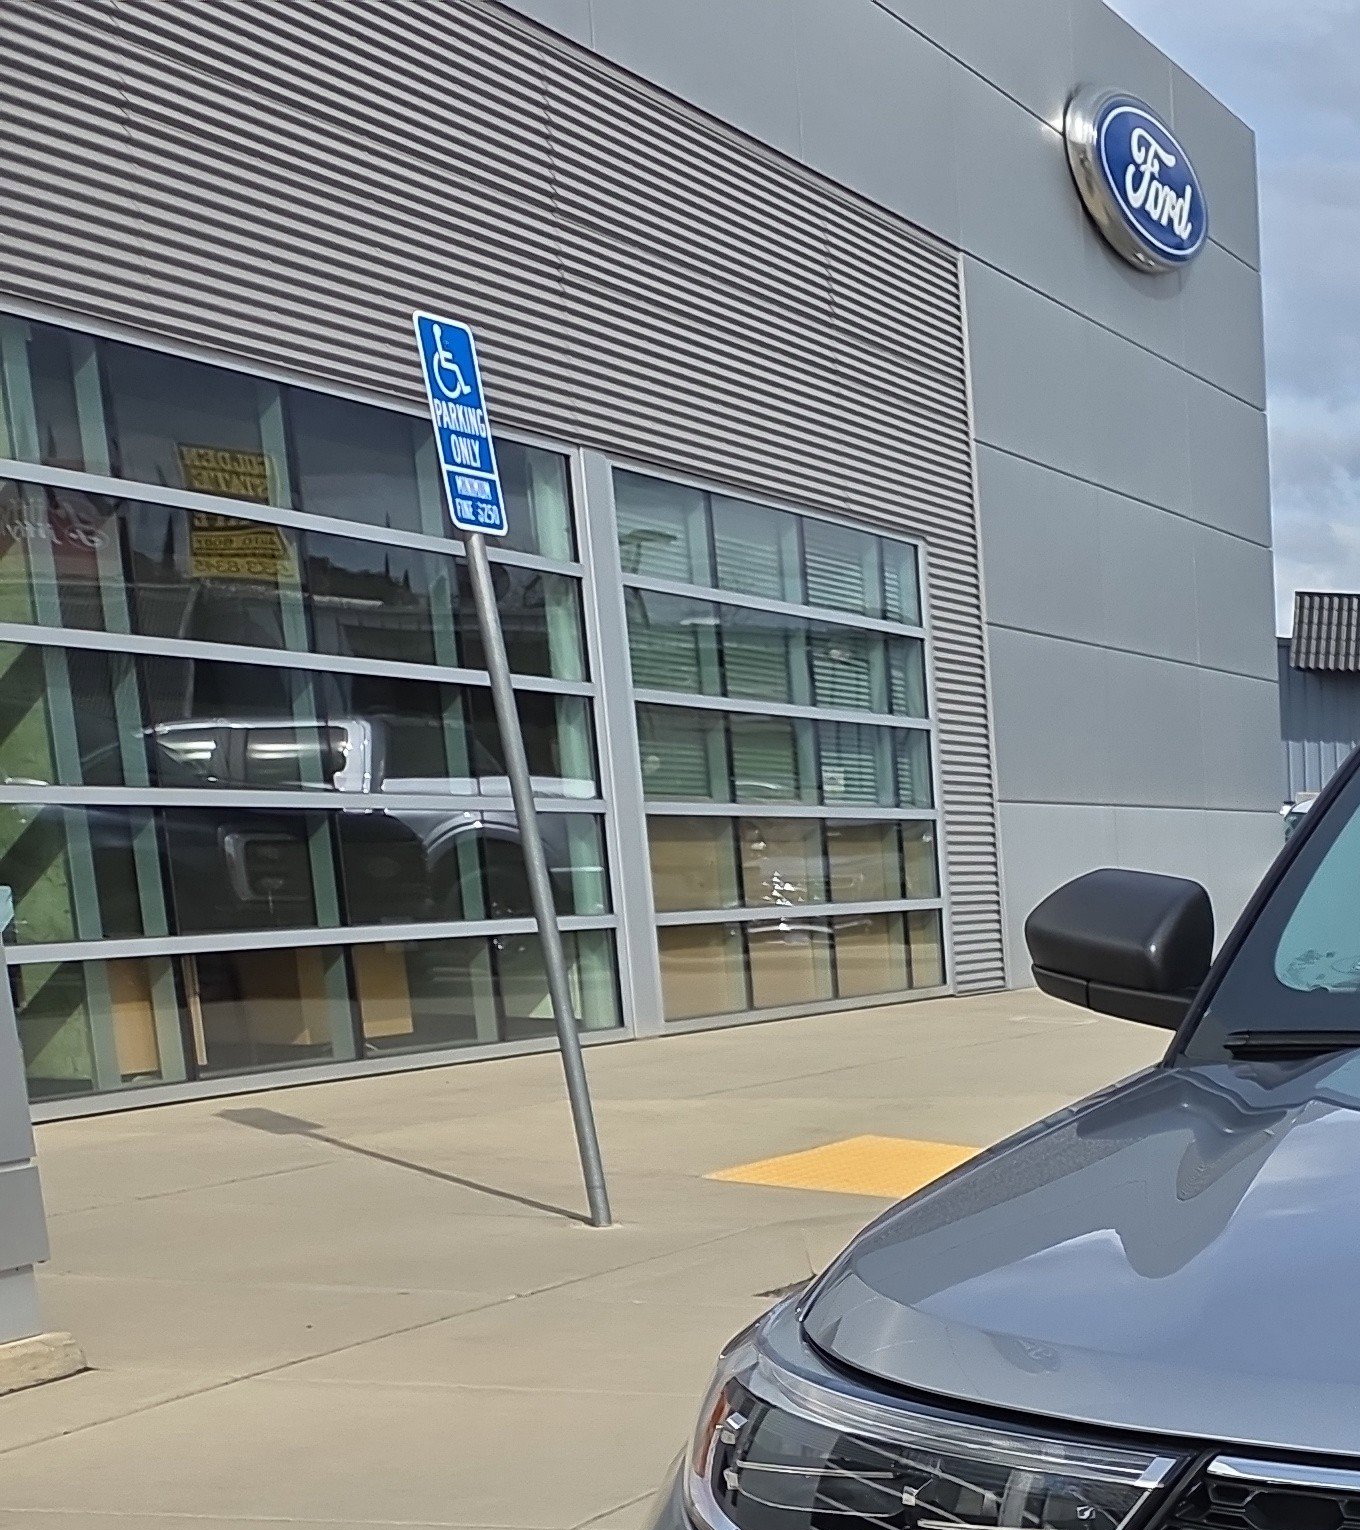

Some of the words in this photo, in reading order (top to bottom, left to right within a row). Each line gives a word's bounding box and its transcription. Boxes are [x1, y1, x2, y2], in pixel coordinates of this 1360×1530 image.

[1125, 127, 1192, 240] Ford
[433, 398, 487, 438] PARKING
[451, 433, 482, 468] ONLY
